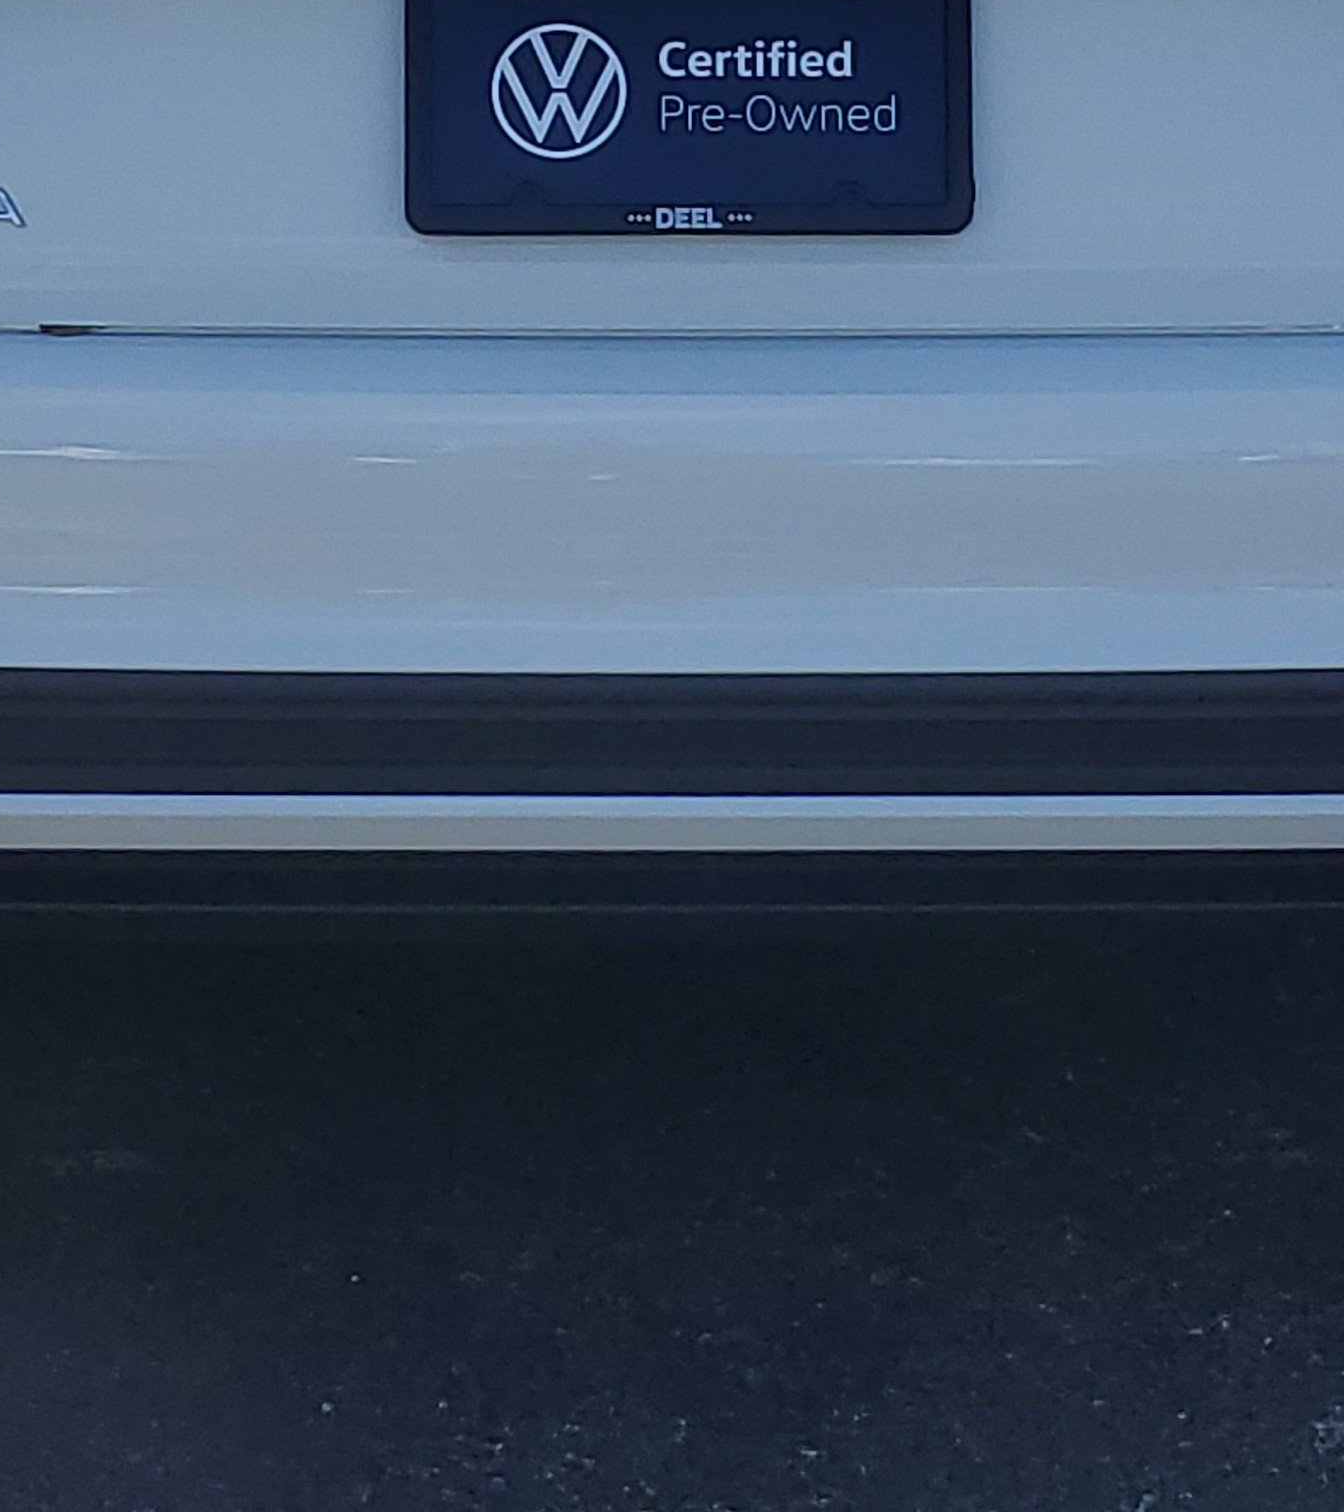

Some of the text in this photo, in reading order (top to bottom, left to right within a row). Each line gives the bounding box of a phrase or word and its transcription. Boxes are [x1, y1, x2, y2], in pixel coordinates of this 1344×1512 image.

[658, 39, 853, 78] Certified
[493, 23, 627, 158] VW
[660, 93, 897, 133] Pre-Owned
[655, 207, 724, 229] DEEL
